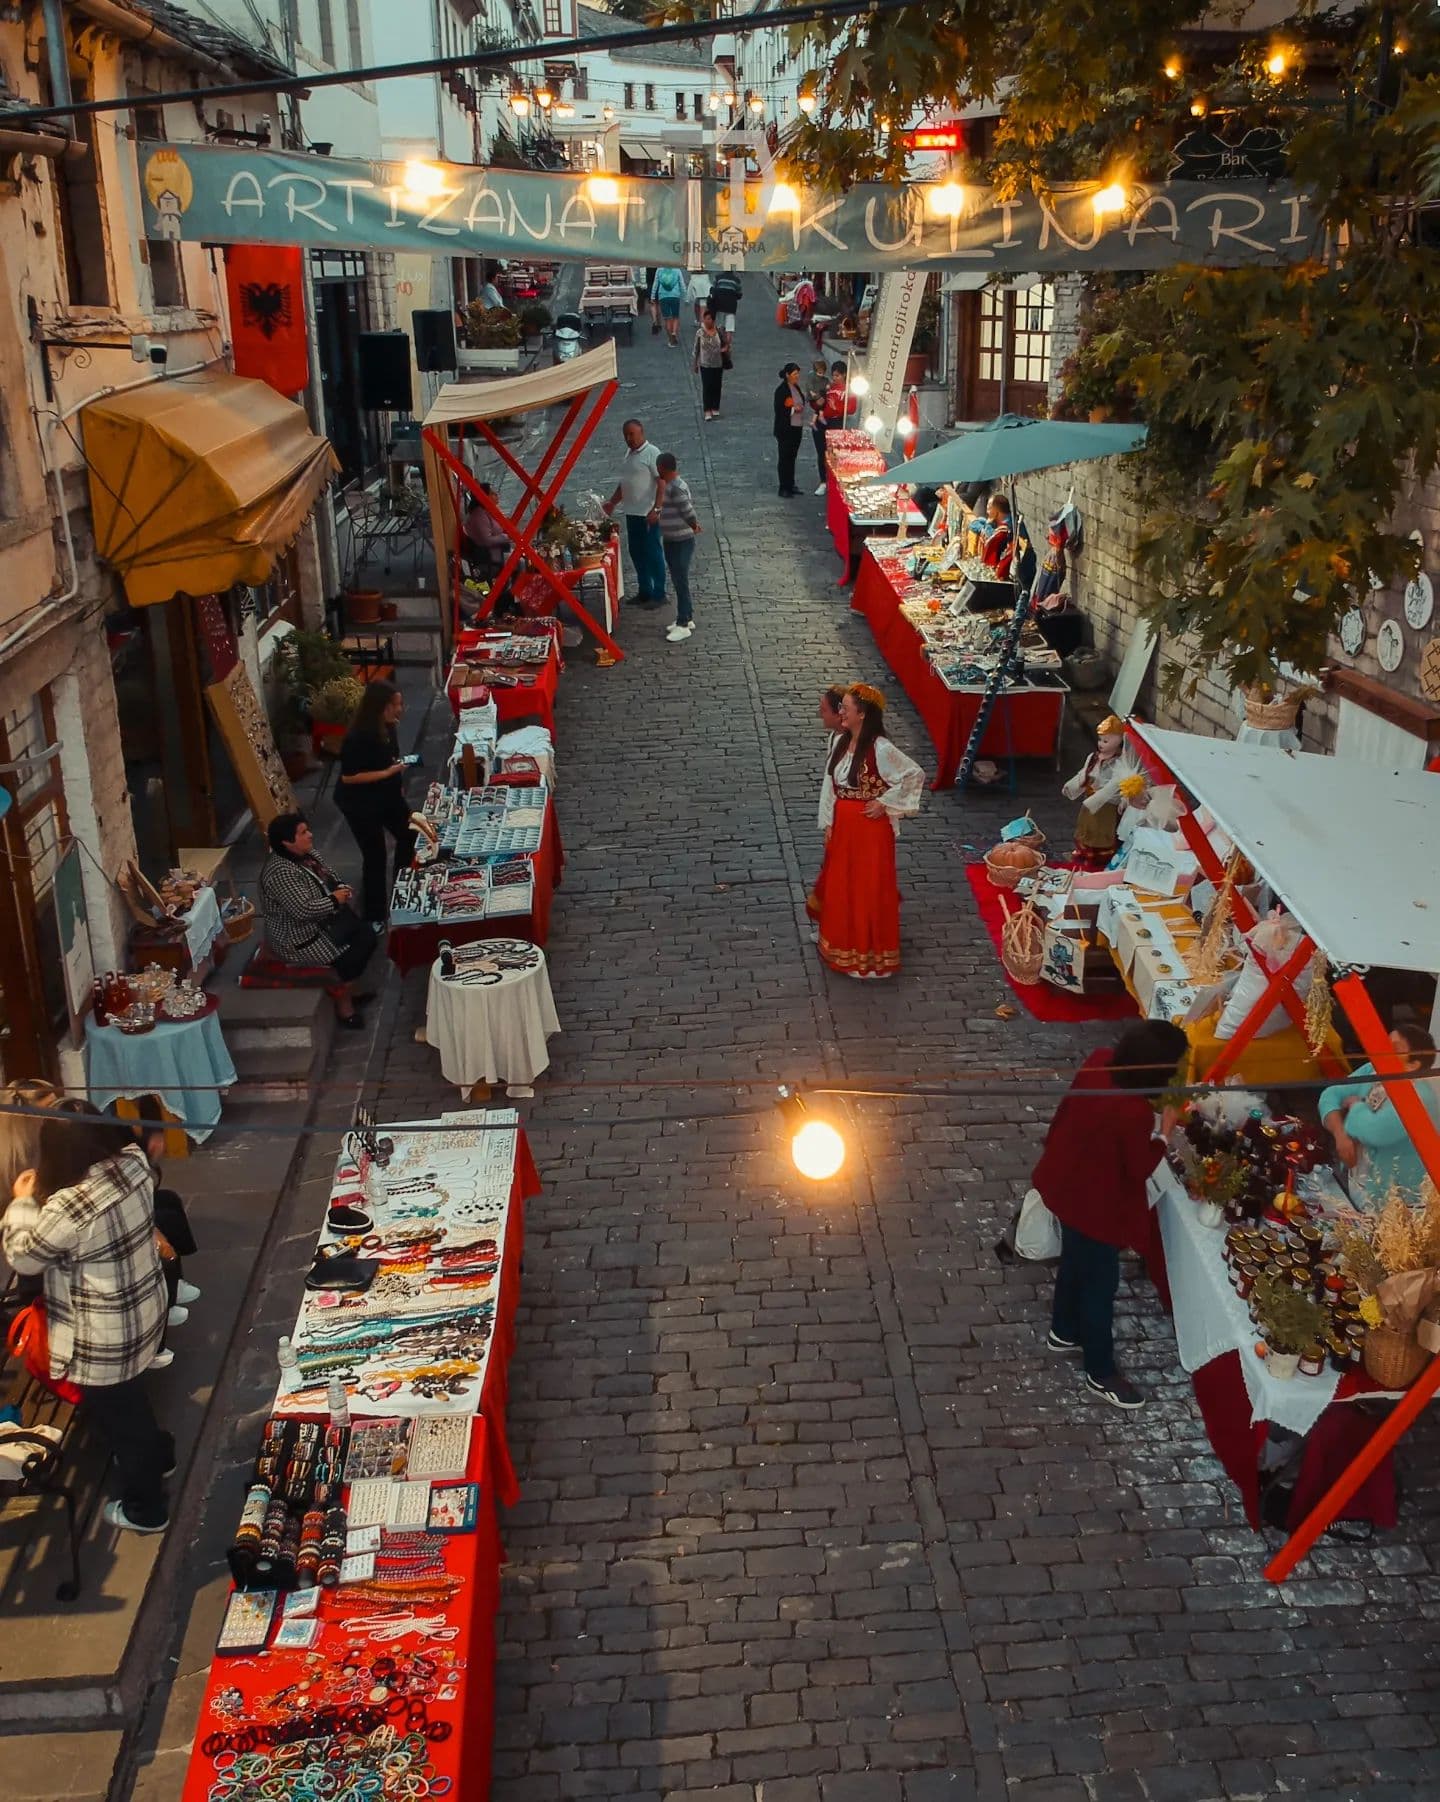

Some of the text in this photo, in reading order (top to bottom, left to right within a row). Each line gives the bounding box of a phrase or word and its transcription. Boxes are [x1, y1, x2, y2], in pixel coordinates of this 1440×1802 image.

[1221, 153, 1248, 166] Bar
[221, 170, 646, 243] ARTIZANAT
[793, 187, 1312, 260] KULINARI
